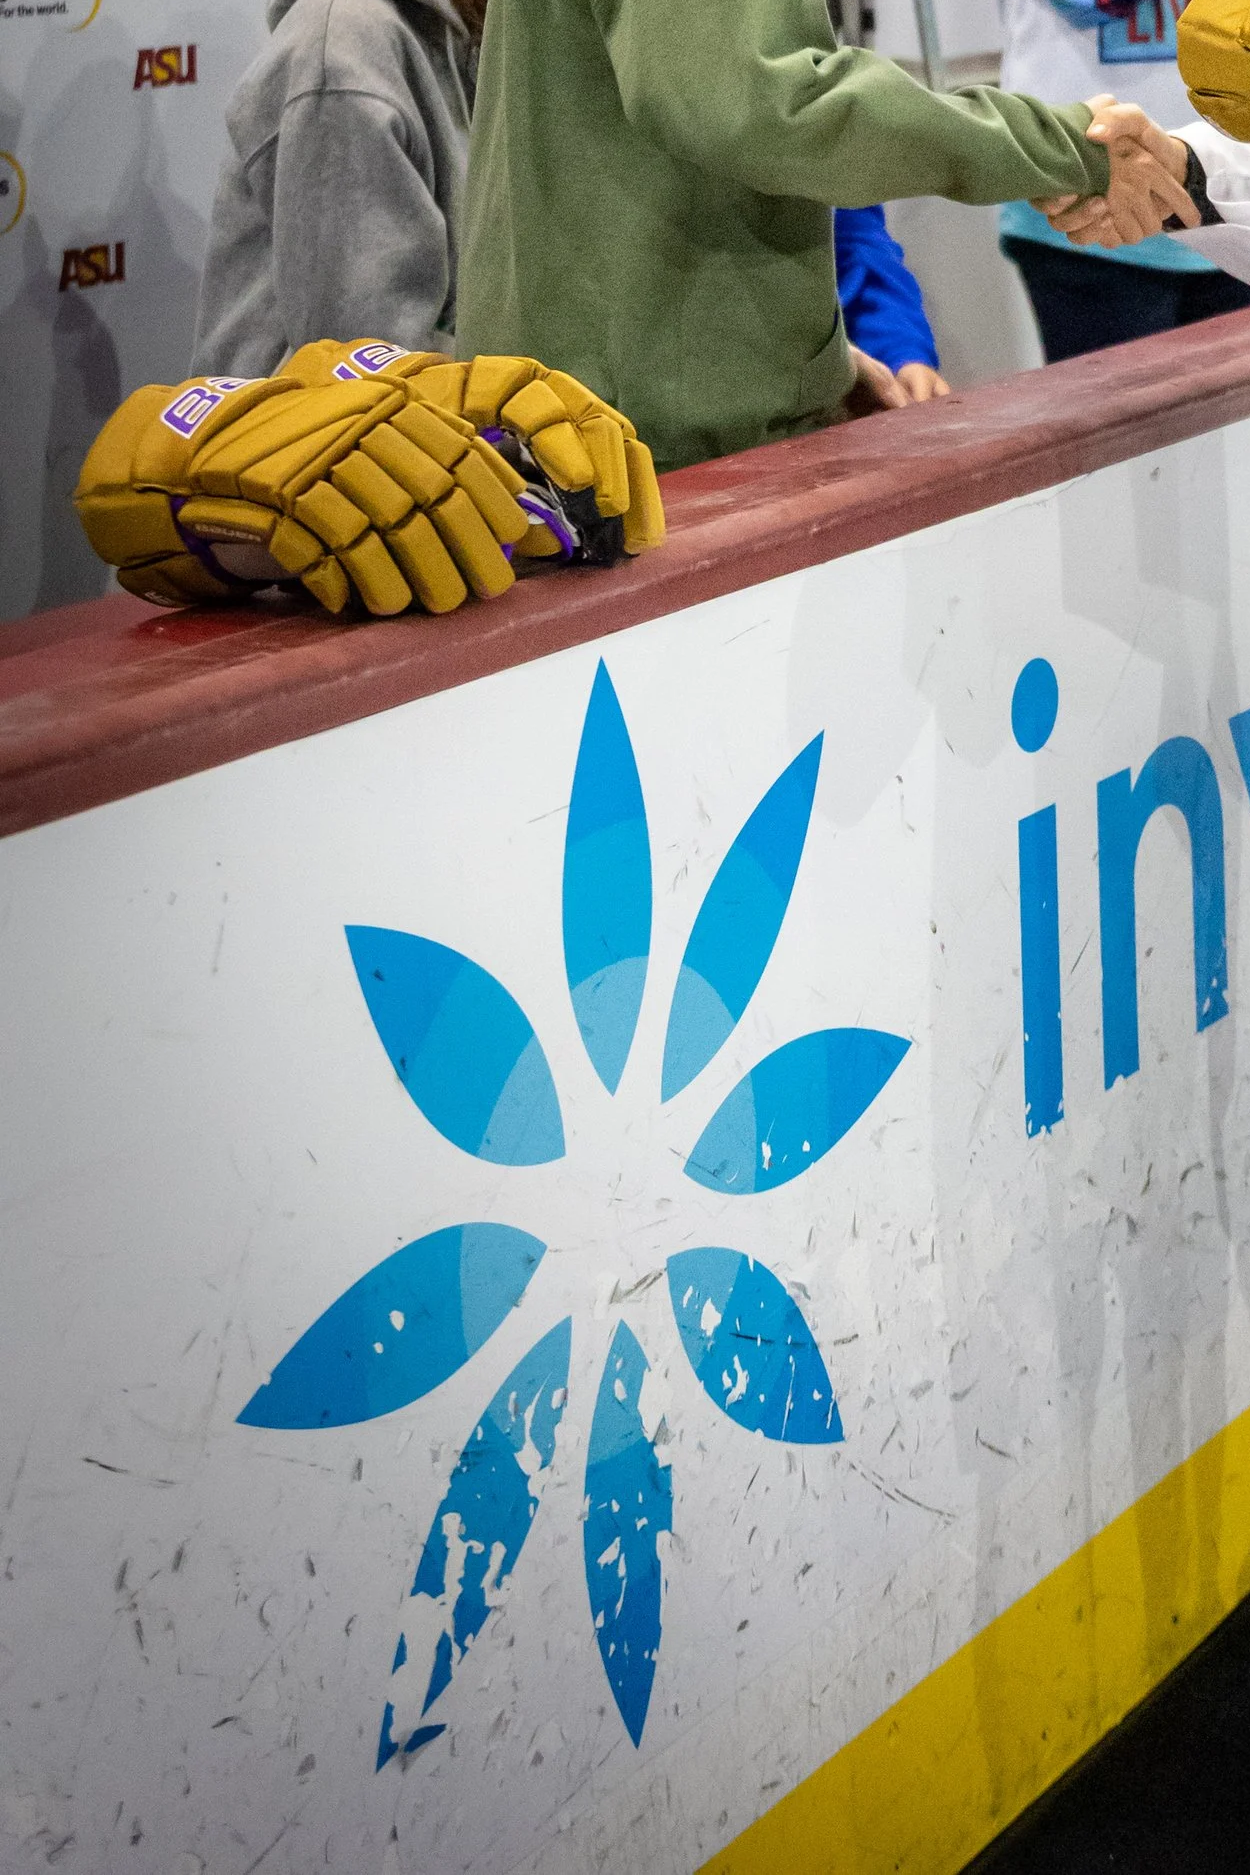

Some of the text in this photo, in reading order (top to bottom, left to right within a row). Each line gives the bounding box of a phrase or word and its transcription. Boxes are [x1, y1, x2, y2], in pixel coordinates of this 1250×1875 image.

[17, 4, 34, 16] the
[132, 43, 198, 91] ASU
[58, 240, 126, 292] ASU
